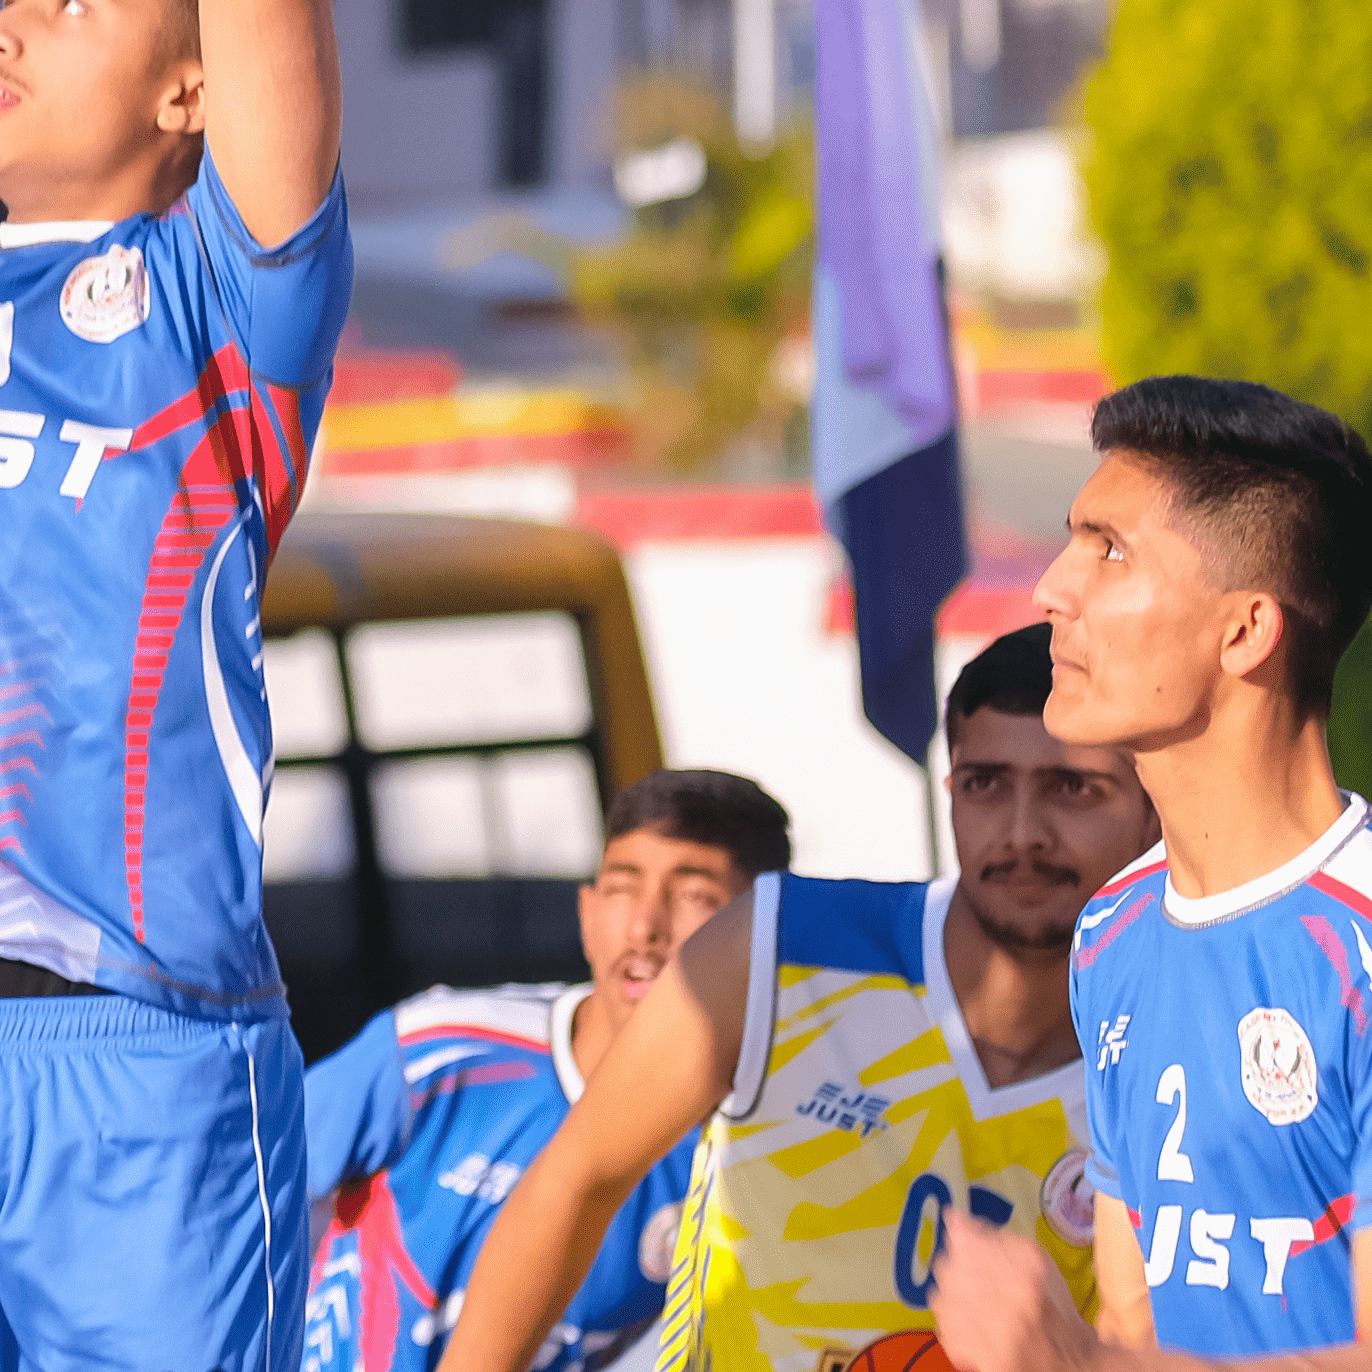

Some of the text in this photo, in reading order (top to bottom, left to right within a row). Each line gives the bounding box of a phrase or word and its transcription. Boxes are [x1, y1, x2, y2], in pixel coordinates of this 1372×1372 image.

[796, 1100, 874, 1138] JUST
[1155, 1063, 1194, 1183] 2
[893, 1173, 1015, 1310] 0
[1144, 1205, 1315, 1295] UST
